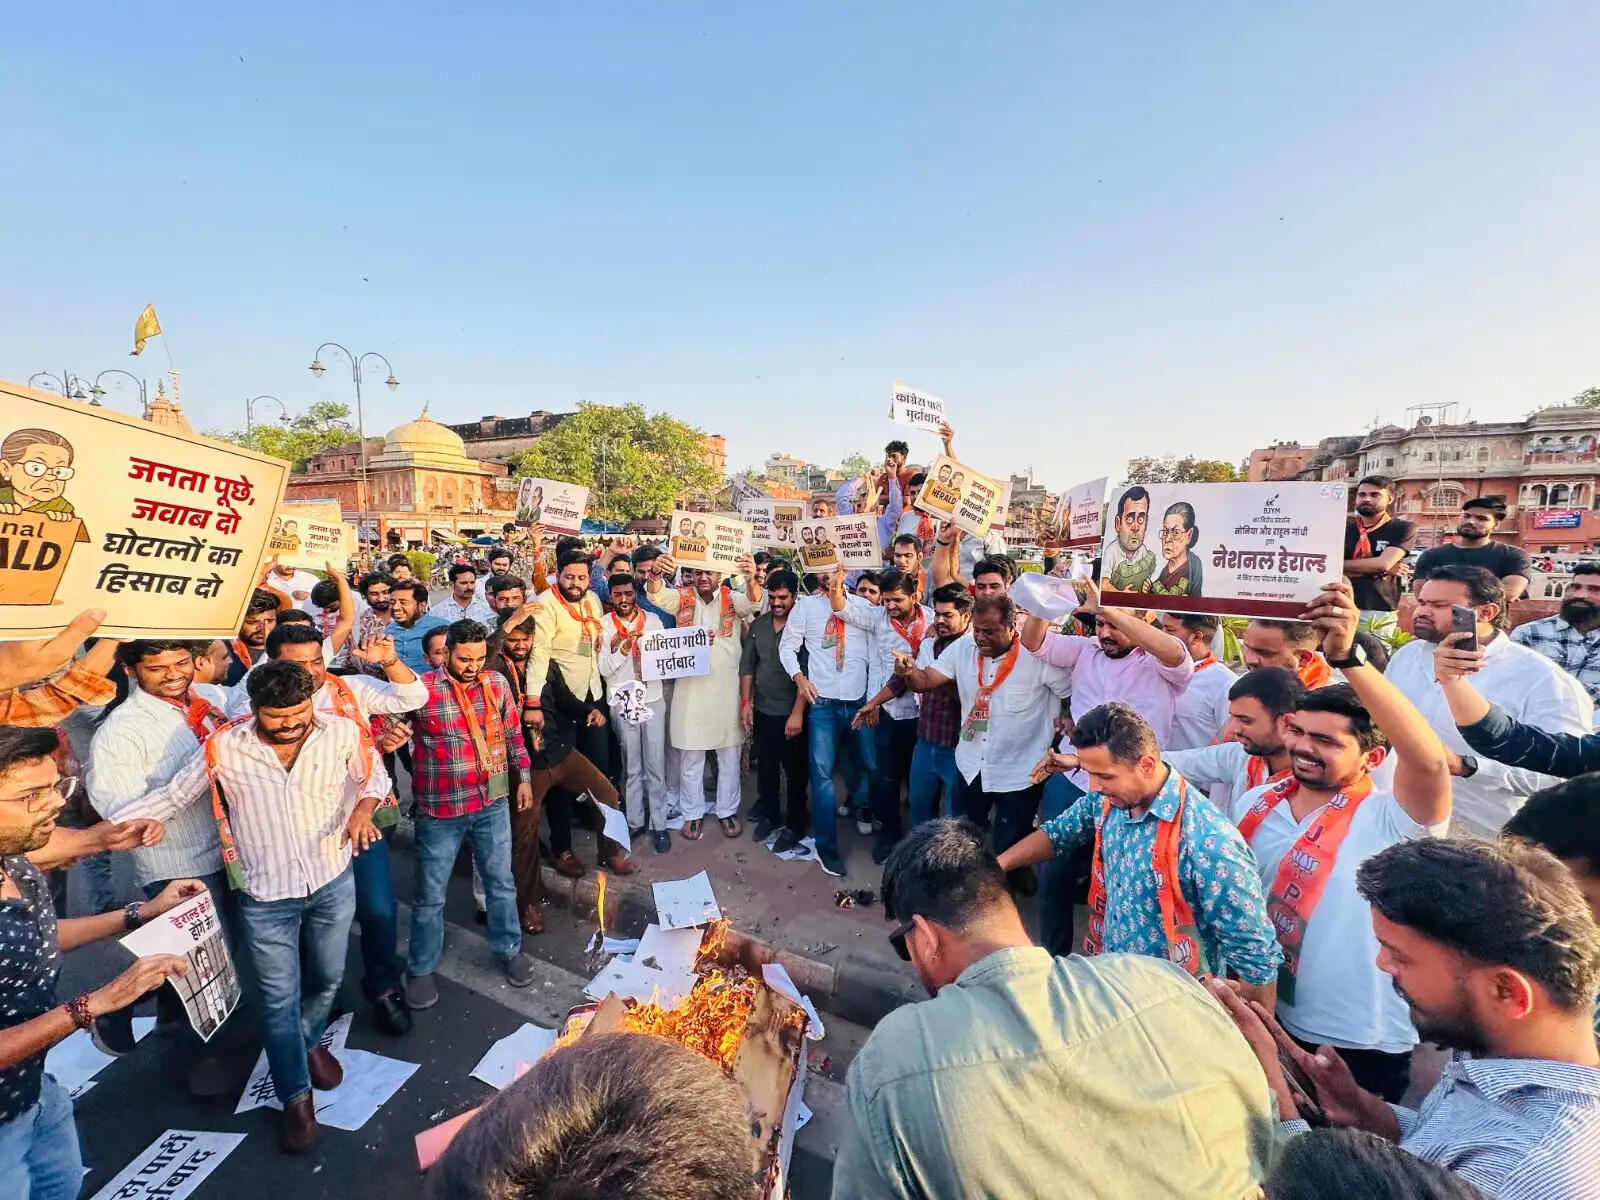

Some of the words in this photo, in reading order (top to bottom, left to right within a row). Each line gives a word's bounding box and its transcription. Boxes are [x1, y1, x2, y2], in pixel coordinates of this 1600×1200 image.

[896, 392, 926, 407] कांग्रेस
[128, 456, 210, 493] जनता
[214, 476, 255, 508] पूछे,
[932, 489, 956, 505] HERALD
[132, 498, 212, 529] जवाब
[216, 508, 242, 534] दो
[834, 524, 853, 532] जनता
[1234, 525, 1258, 536] सोनिया
[1259, 525, 1272, 536] और
[1273, 528, 1290, 538] राहुल
[1291, 526, 1308, 536] गांधी
[102, 528, 206, 563] घोटालों
[208, 545, 243, 567] का
[680, 543, 706, 552] HERALD
[808, 550, 834, 559] HERALD
[864, 550, 872, 558] दो
[1212, 544, 1276, 570] नेशनल
[1278, 546, 1327, 574] हेराल्ड
[96, 564, 192, 596] हिसाब
[194, 573, 223, 598] दो
[644, 634, 680, 652] सोनिया
[682, 629, 706, 648] गांधी
[656, 652, 696, 676] मुर्दाबाद
[168, 906, 200, 928] हेराल्ड
[198, 902, 206, 914] के
[137, 1134, 196, 1175] पार्टी
